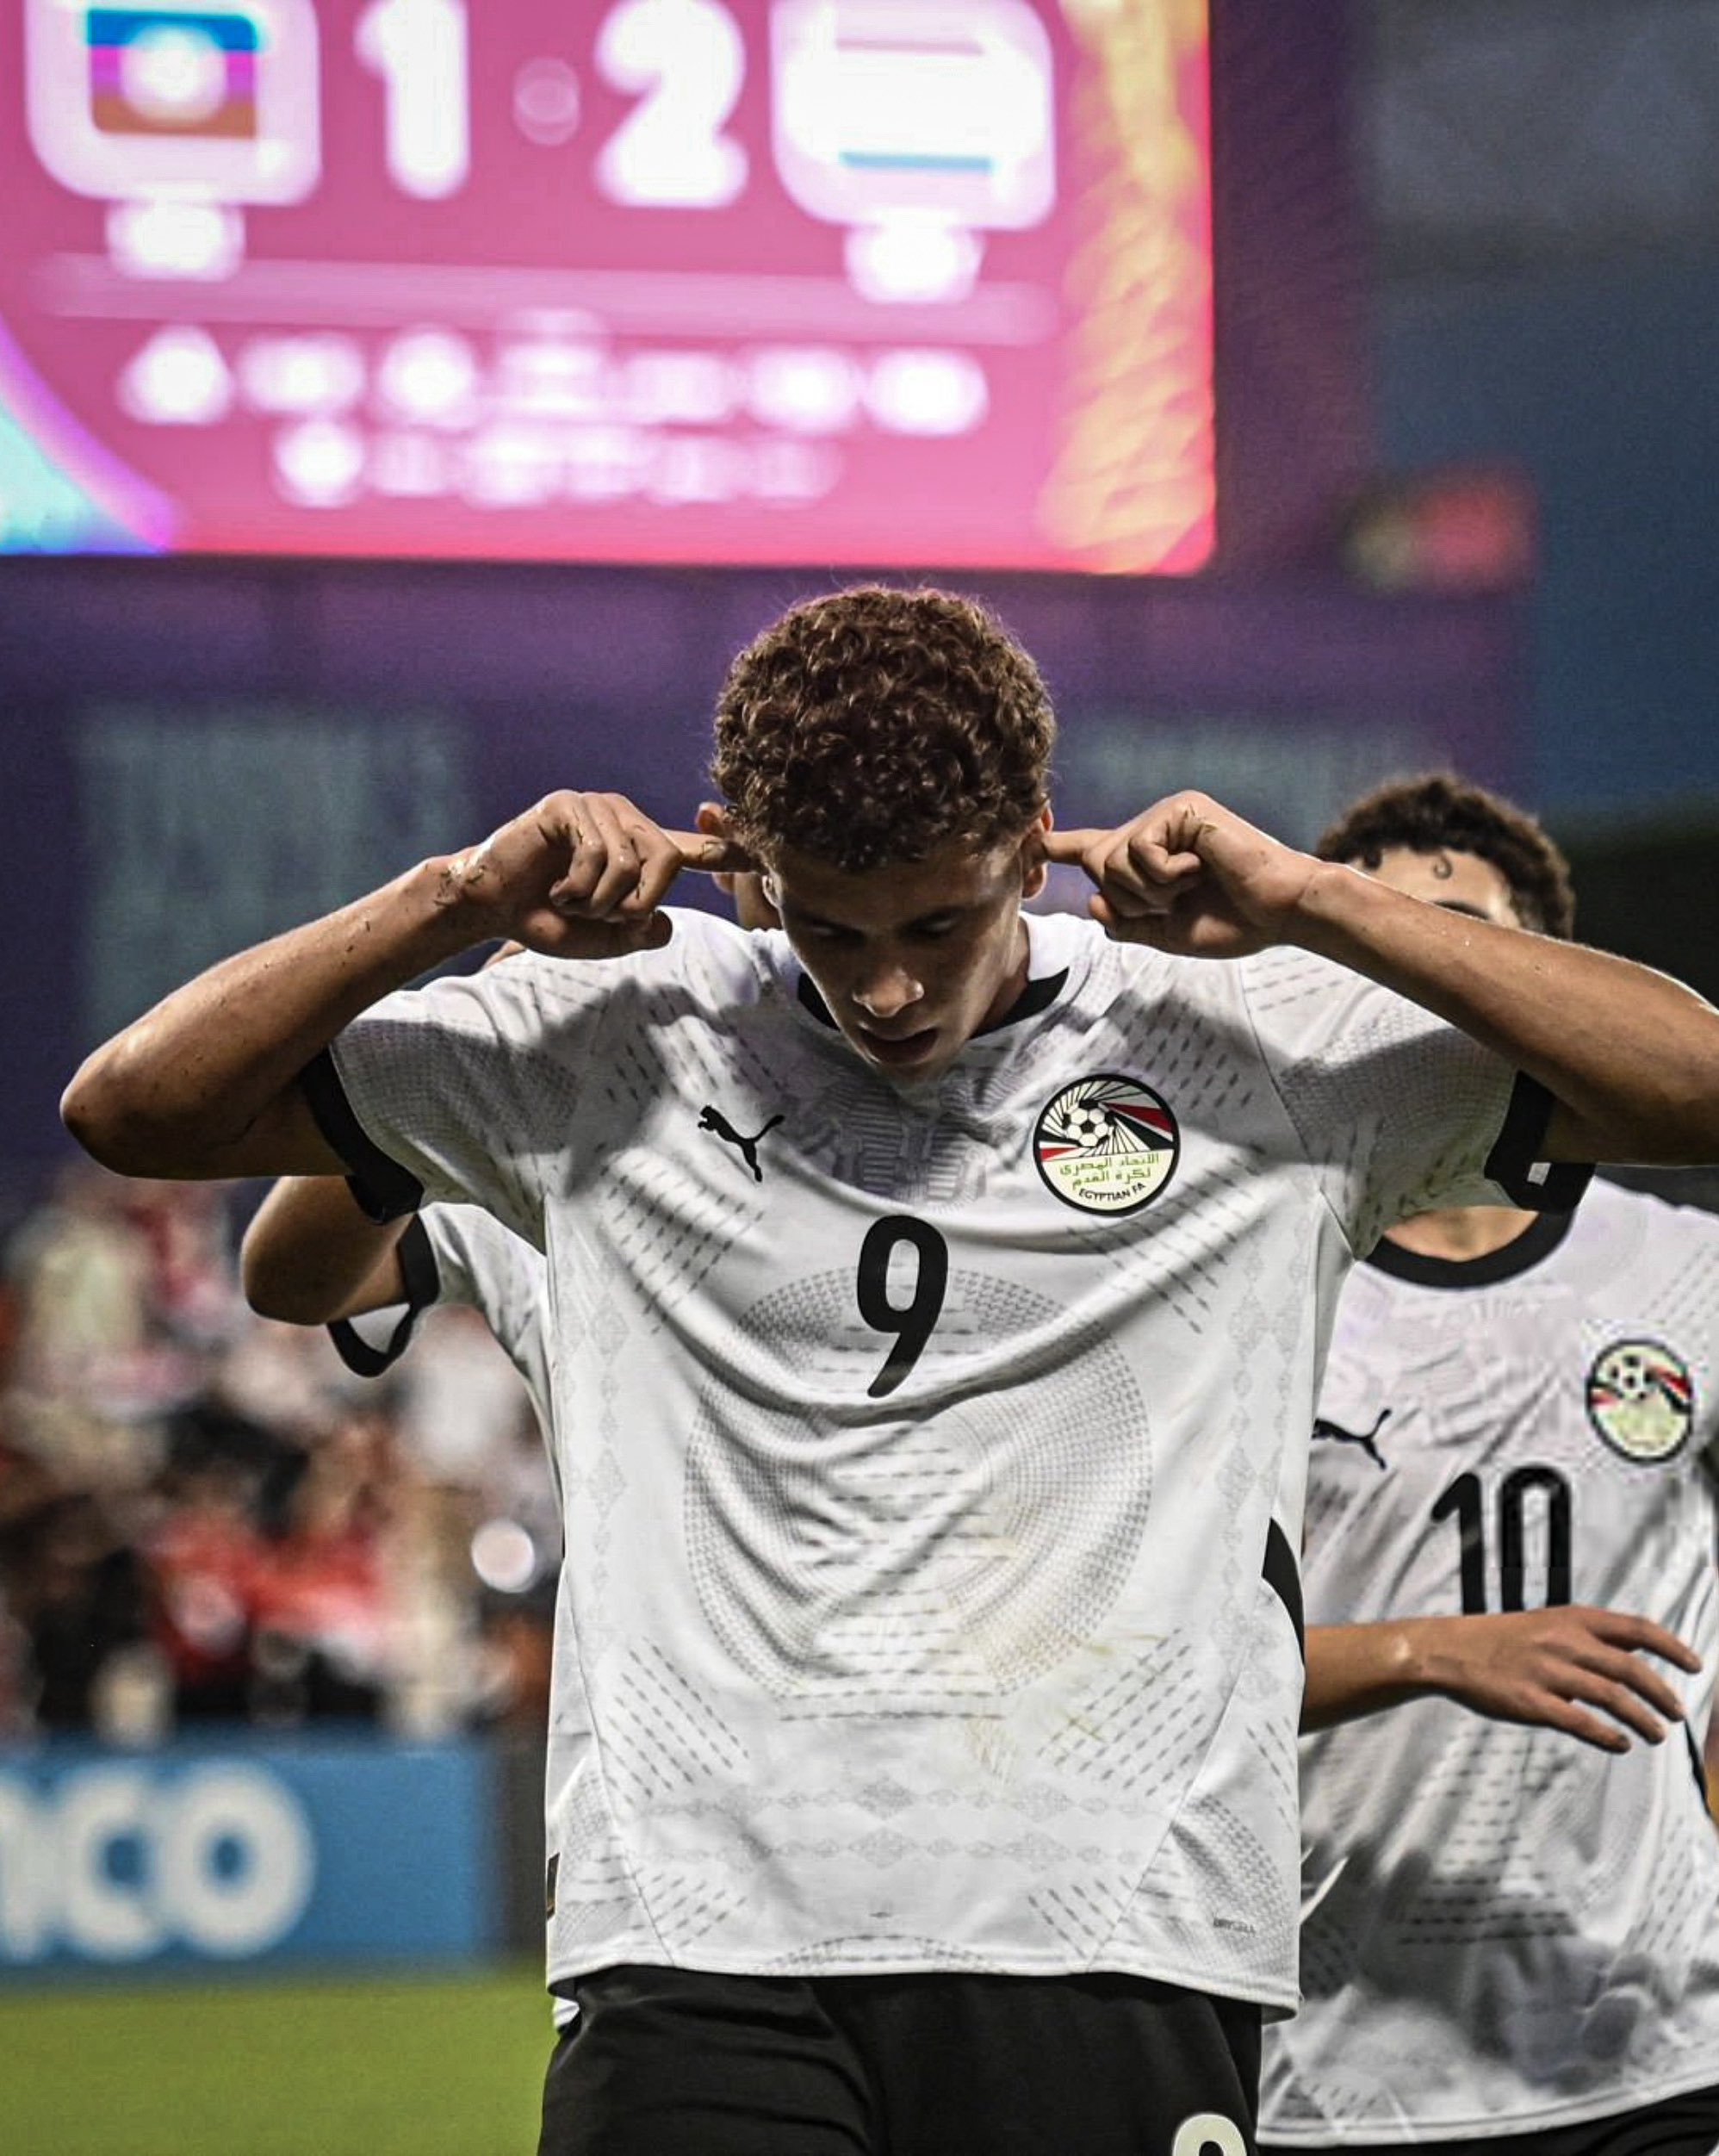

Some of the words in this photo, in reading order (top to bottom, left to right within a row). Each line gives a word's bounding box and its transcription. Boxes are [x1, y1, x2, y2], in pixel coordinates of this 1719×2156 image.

[353, 0, 470, 200] 1
[594, 0, 749, 208] 2
[1078, 1189, 1131, 1202] EGYPTIAN
[1131, 1182, 1146, 1194] FA
[857, 1215, 948, 1399] 9
[1430, 1464, 1572, 1617] 10
